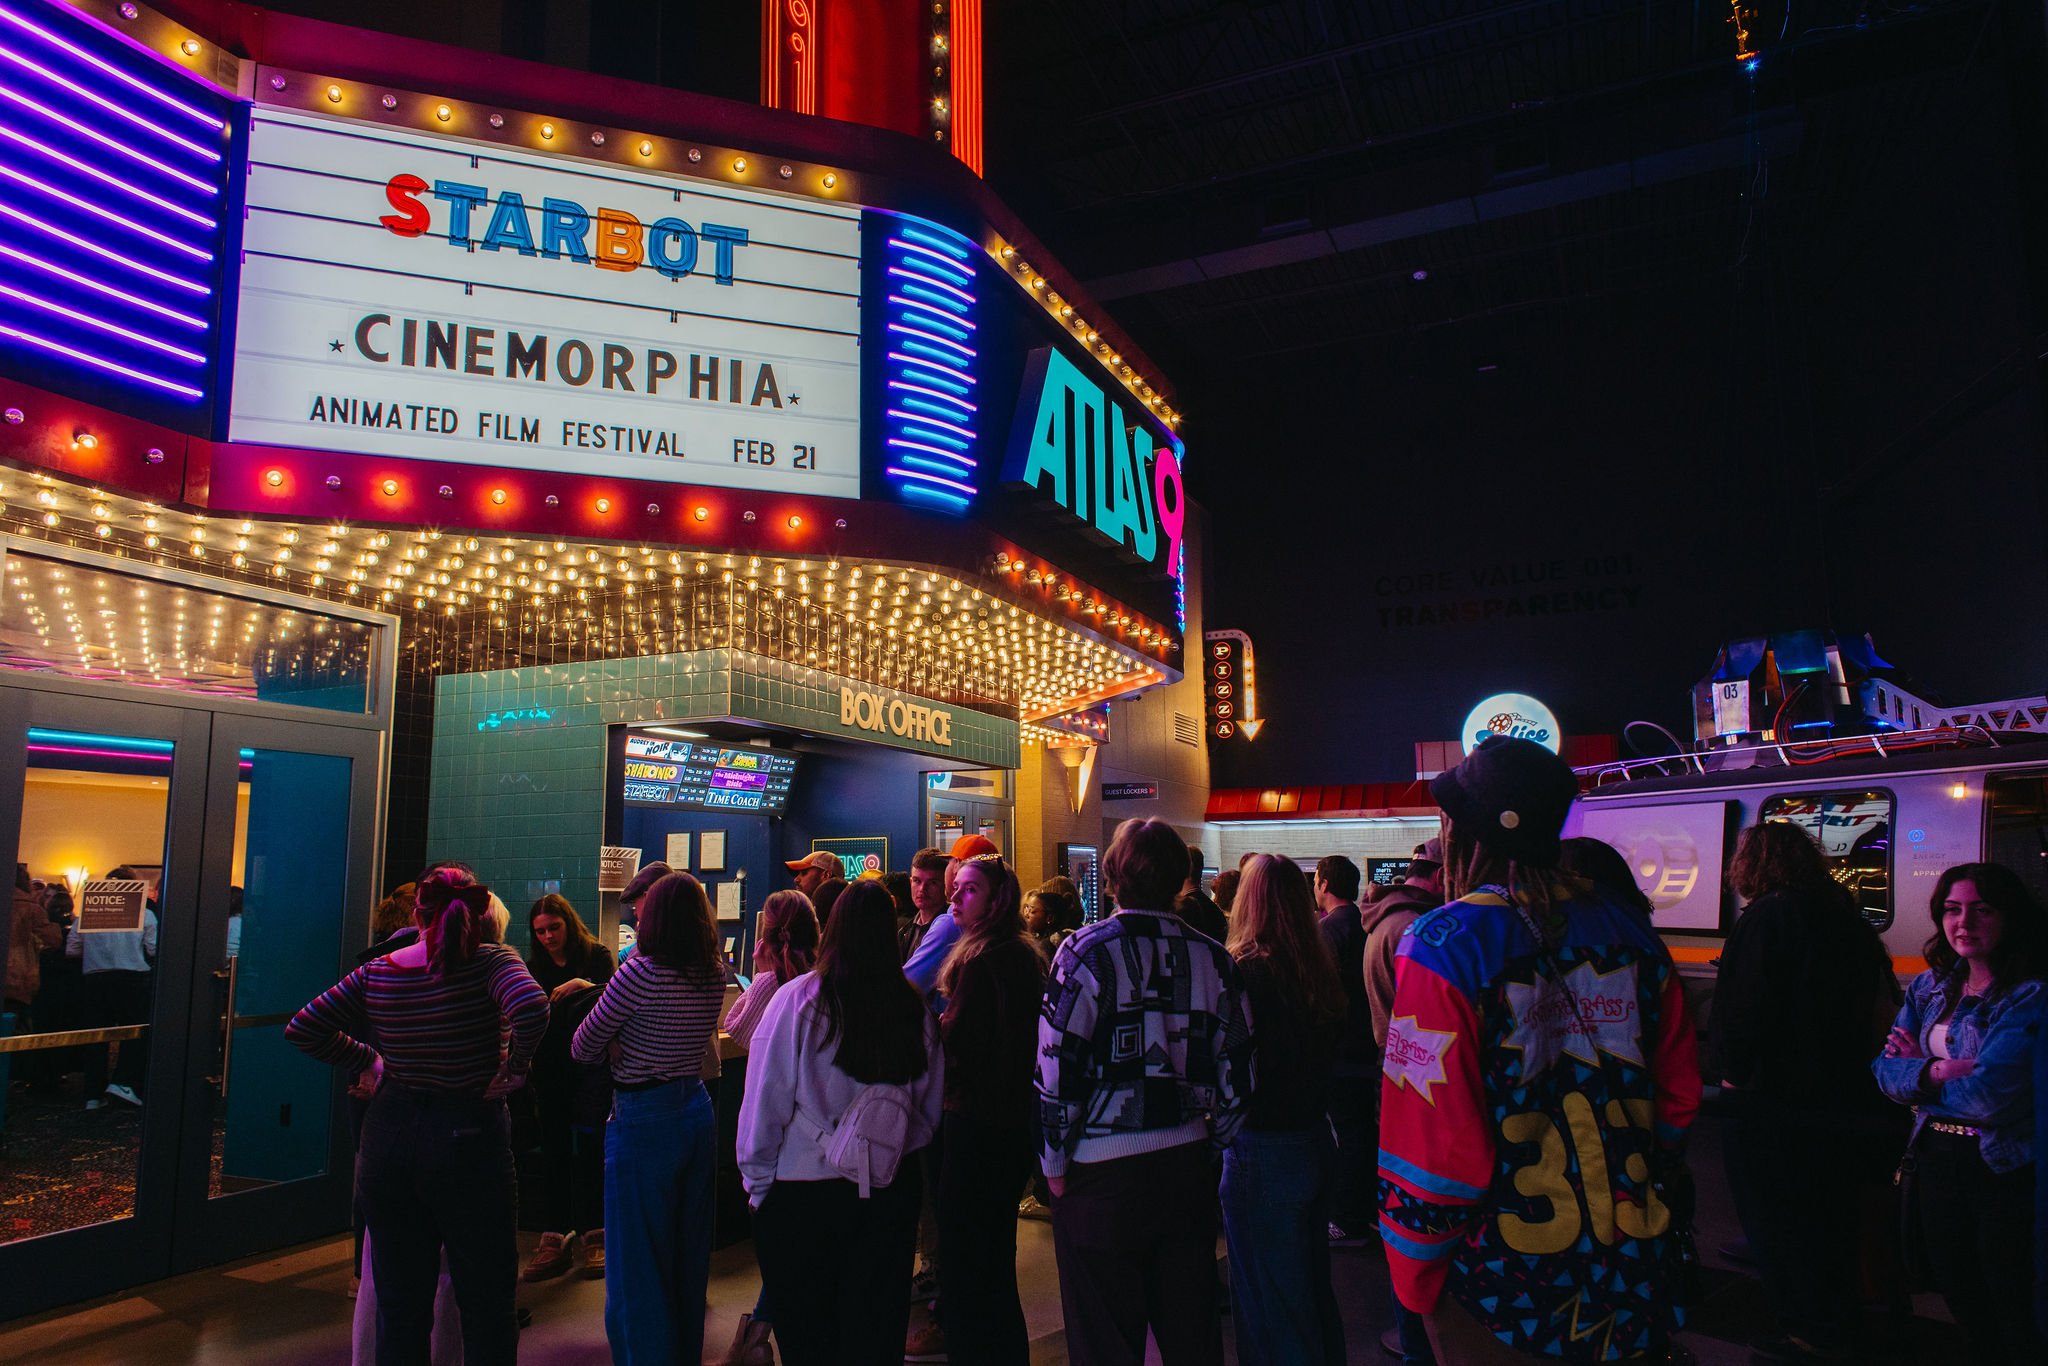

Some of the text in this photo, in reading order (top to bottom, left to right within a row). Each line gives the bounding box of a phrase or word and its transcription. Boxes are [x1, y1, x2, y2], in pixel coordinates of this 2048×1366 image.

[379, 173, 749, 287] STARBOT
[354, 313, 783, 409] CINEMORPHIA
[309, 395, 817, 470] ANIMATED FILM FESTIVAL FEB 21
[1375, 571, 1454, 597] CORE
[1471, 559, 1568, 588] VALUE
[1376, 584, 1643, 628] TRANSPARENCY
[1215, 645, 1232, 735] PIZZA
[1723, 683, 1738, 700] 03
[841, 686, 952, 746] BOX OFFICE
[645, 742, 669, 756] NOIR
[1473, 725, 1550, 749] Slice
[723, 771, 756, 782] Midnight
[1123, 787, 1148, 795] LOCKERS
[708, 791, 731, 805] TIME
[731, 793, 760, 807] COACH
[85, 895, 126, 905] NOTICE:
[1496, 1090, 1671, 1255] 313
